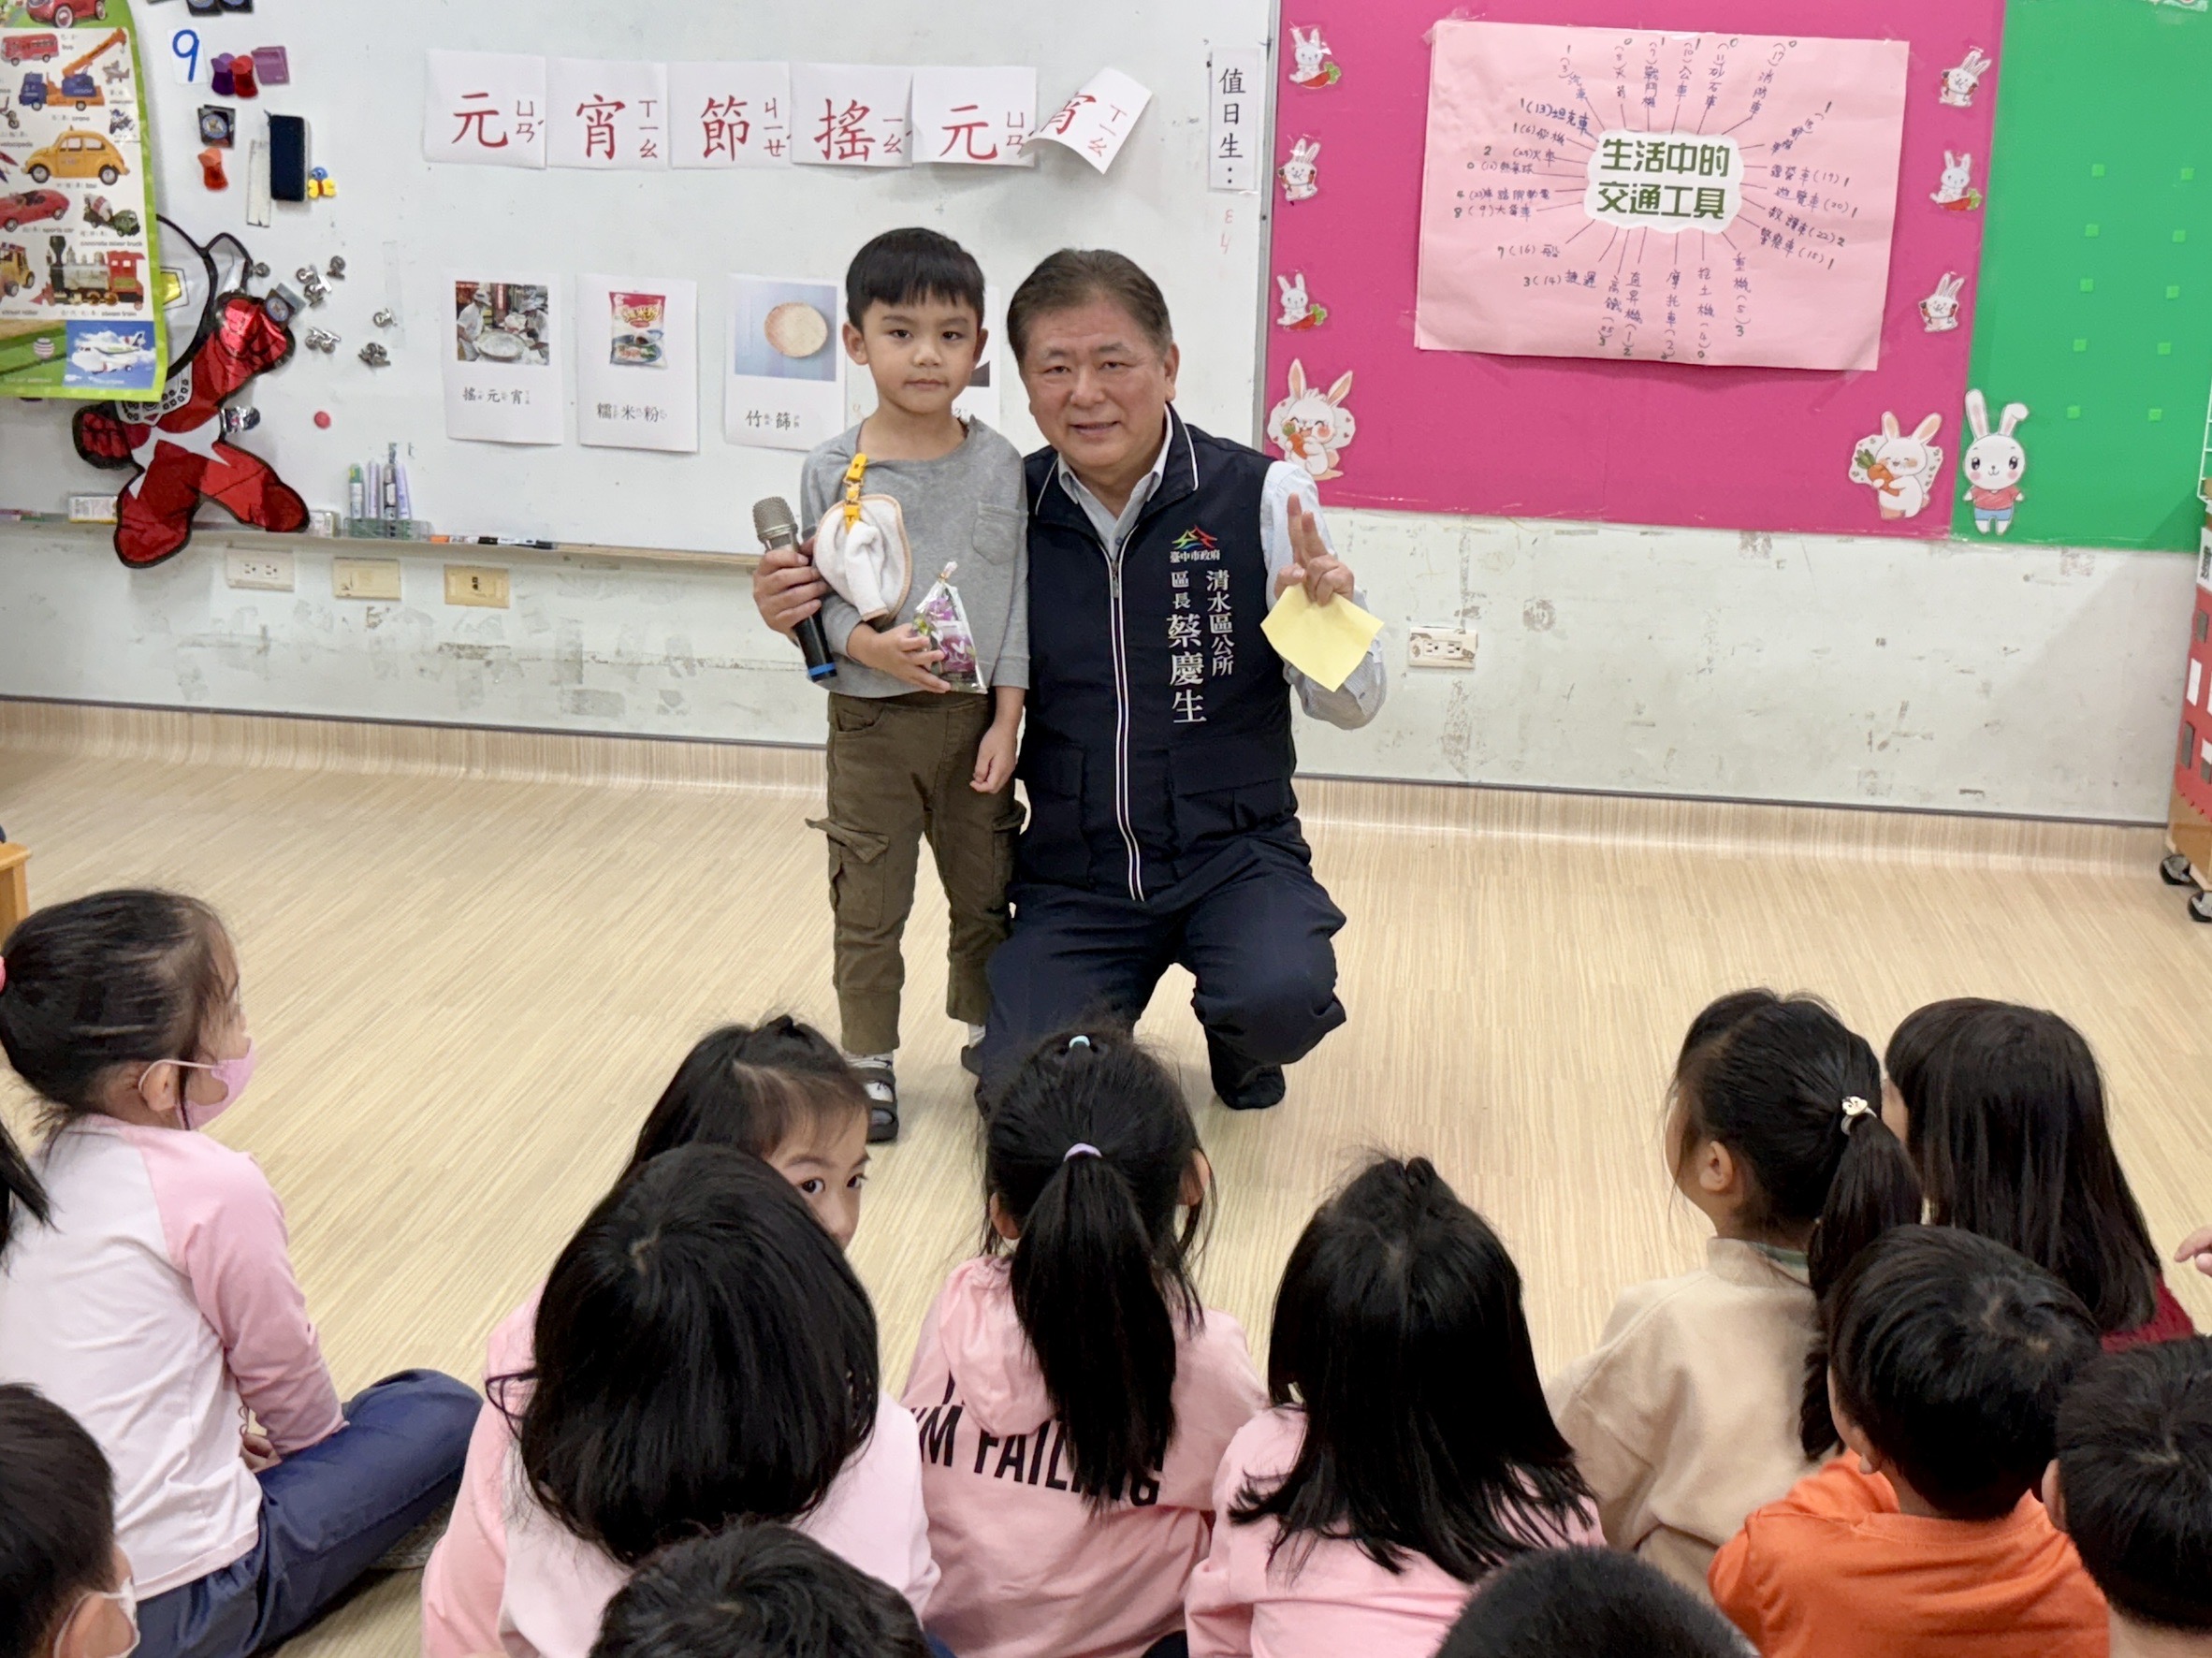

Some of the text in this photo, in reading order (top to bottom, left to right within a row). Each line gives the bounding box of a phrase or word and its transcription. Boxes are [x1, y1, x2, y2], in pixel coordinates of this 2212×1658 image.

[172, 29, 199, 82] 9
[1601, 138, 1730, 177] 生活中的
[1596, 182, 1725, 220] 交通工具
[1170, 549, 1220, 563] 臺中市政府
[1206, 569, 1234, 676] 清水區公所
